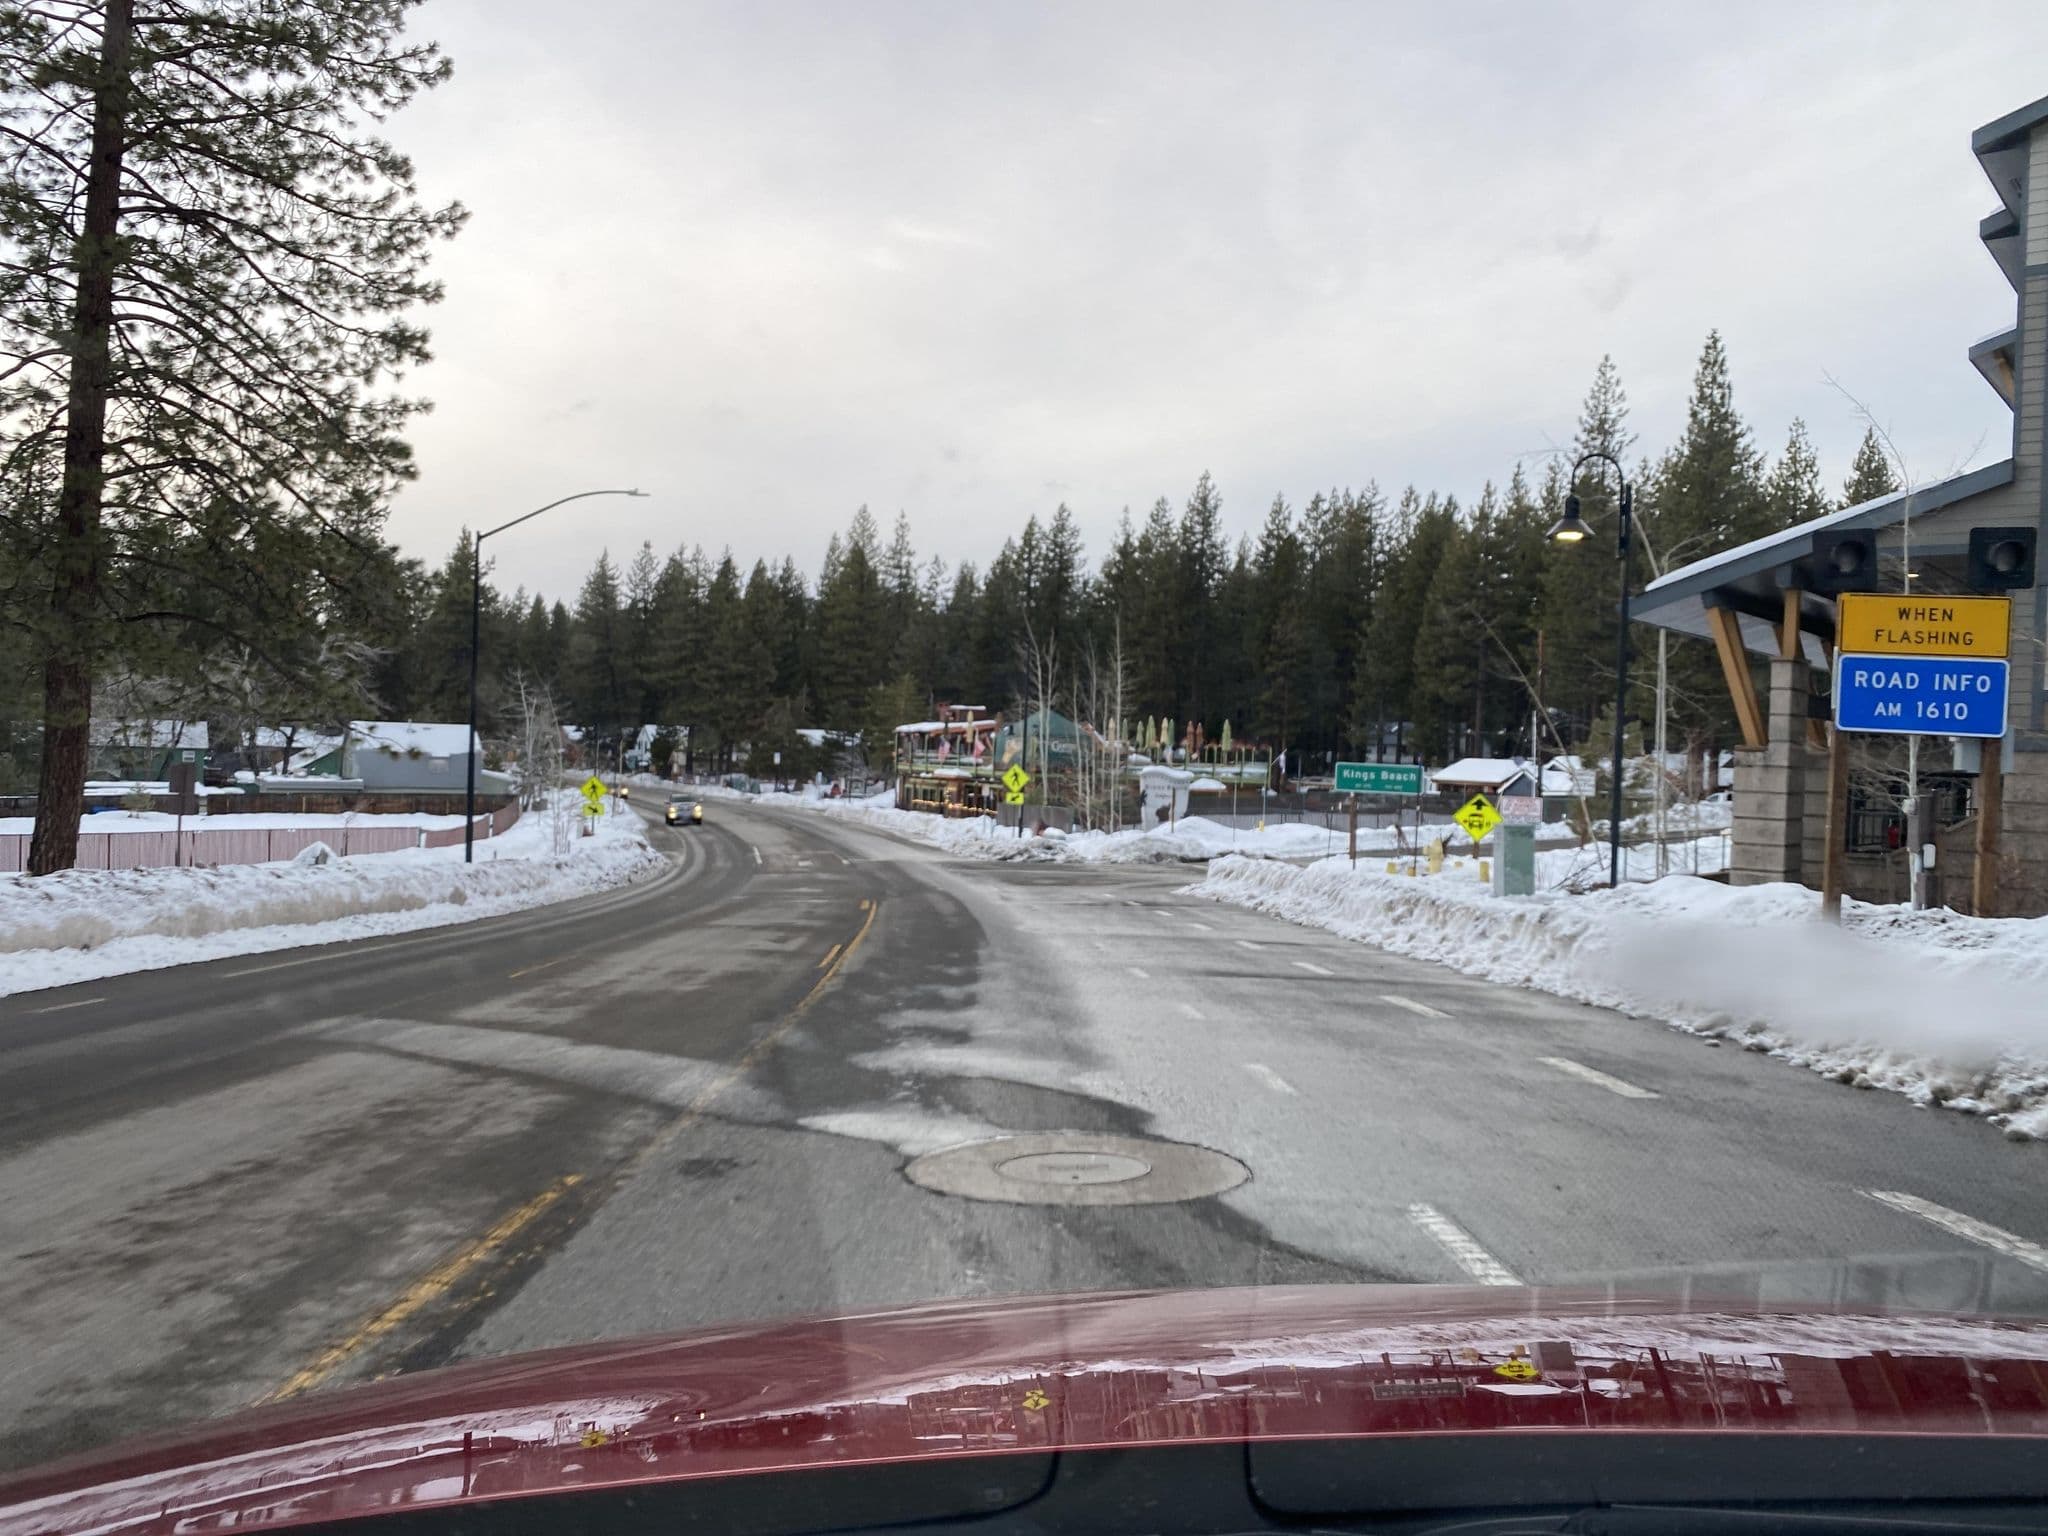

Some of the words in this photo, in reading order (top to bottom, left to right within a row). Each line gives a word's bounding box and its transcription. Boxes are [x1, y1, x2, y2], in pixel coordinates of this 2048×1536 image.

[1898, 607, 1954, 622] WHEN
[1874, 629, 1974, 646] FLASHING
[1854, 670, 1920, 690] ROAD
[1934, 673, 1992, 693] INFO
[1873, 702, 1902, 717] AM
[1917, 701, 1968, 720] 1610
[1343, 769, 1376, 781] Kings
[1380, 770, 1417, 781] Beach
